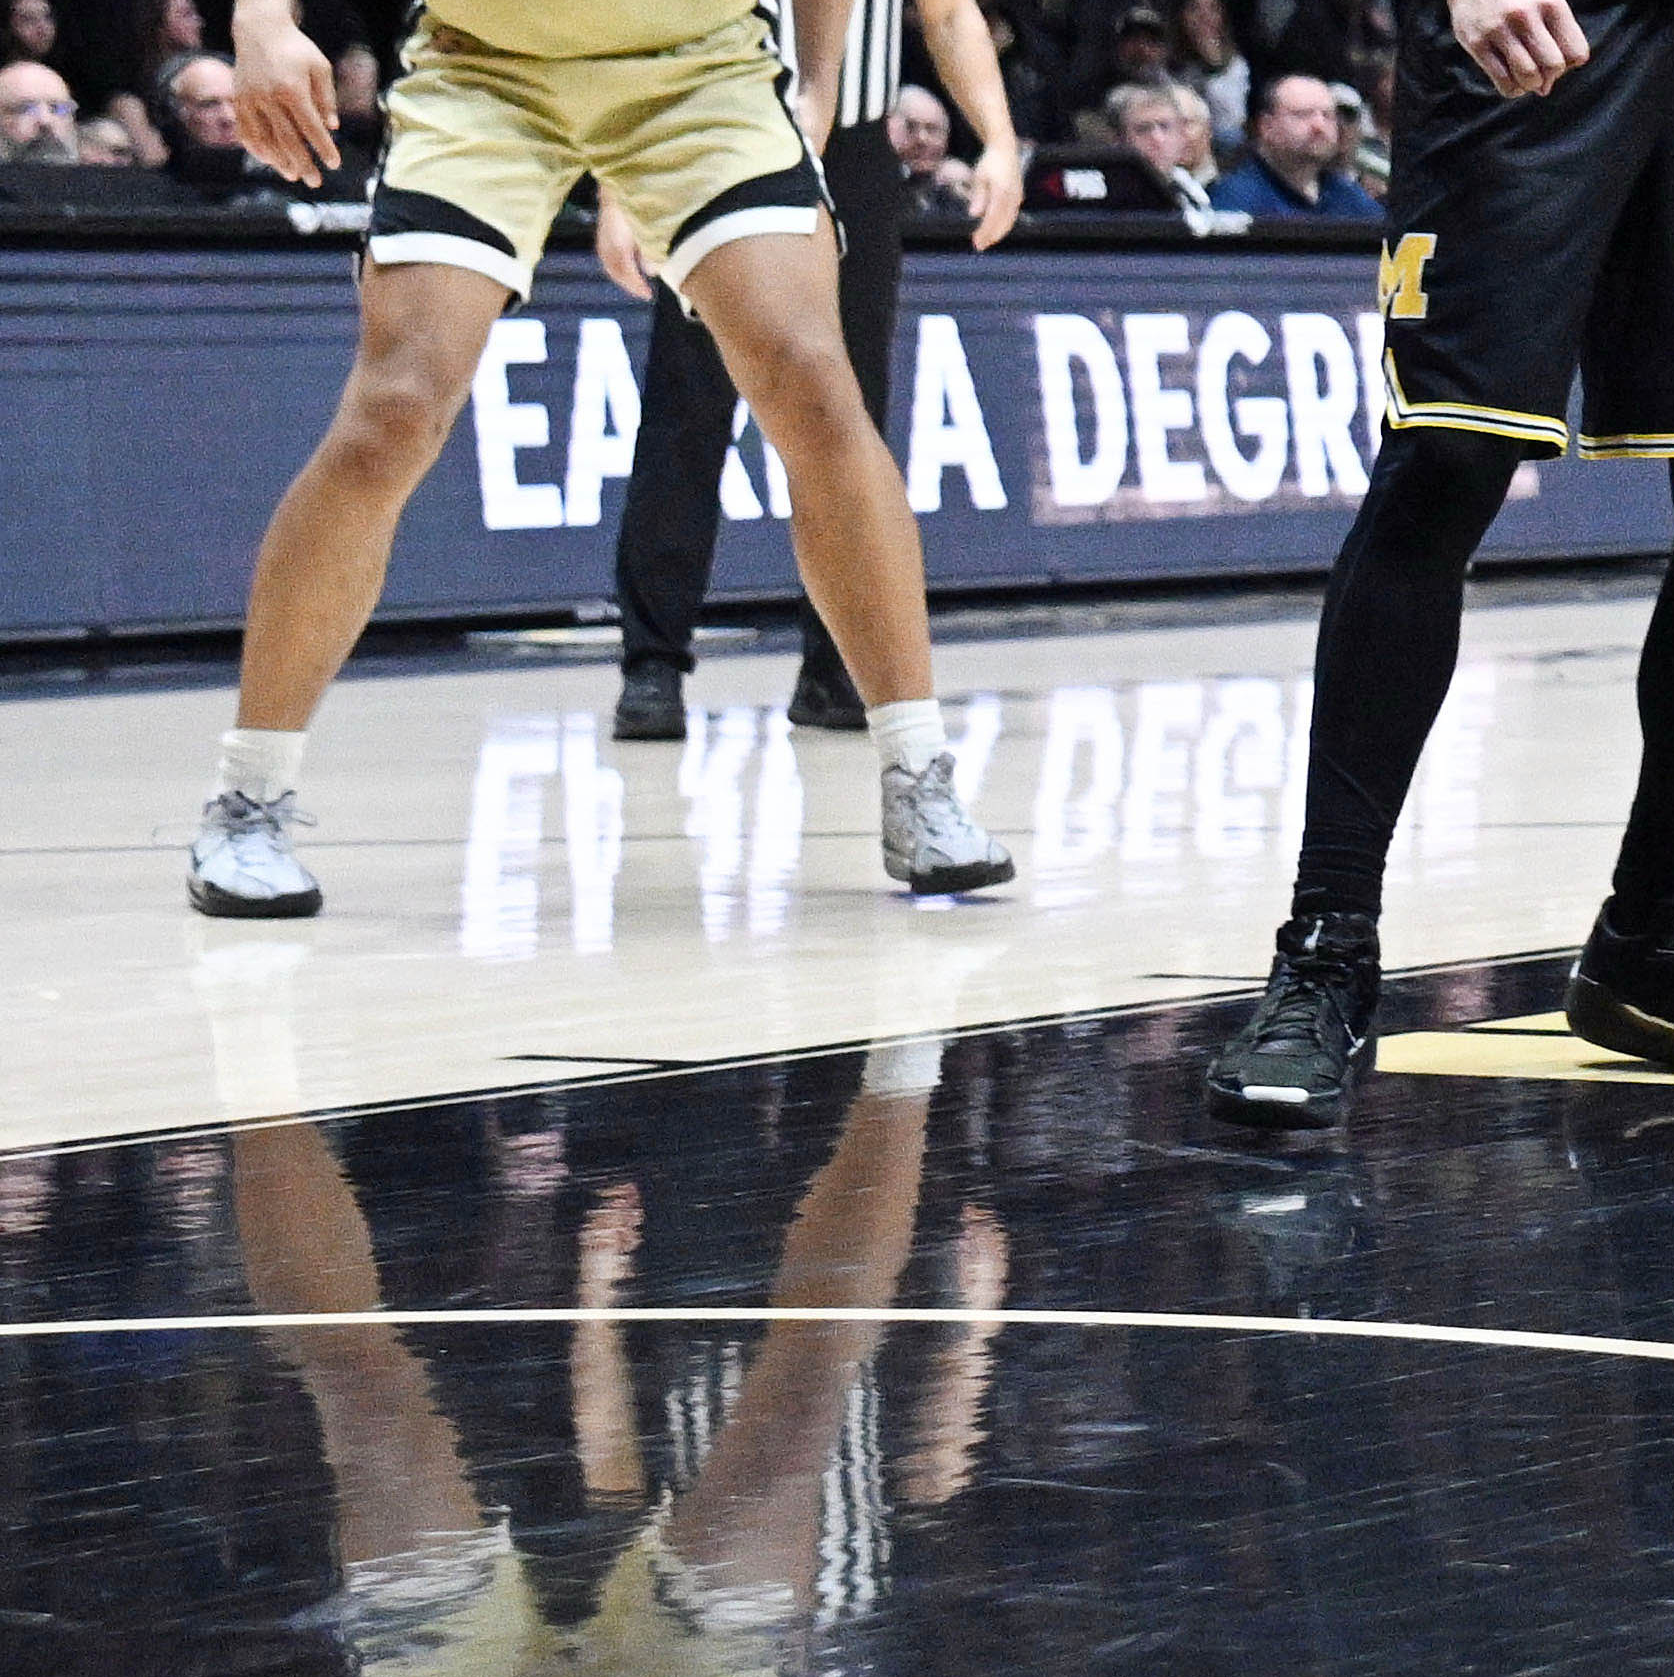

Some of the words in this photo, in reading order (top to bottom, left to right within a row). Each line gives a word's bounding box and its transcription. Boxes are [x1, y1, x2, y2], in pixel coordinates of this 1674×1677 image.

[1378, 232, 1437, 320] M
[472, 317, 794, 531] EA
[908, 314, 1008, 513] A
[1034, 310, 1386, 506] DEGR
